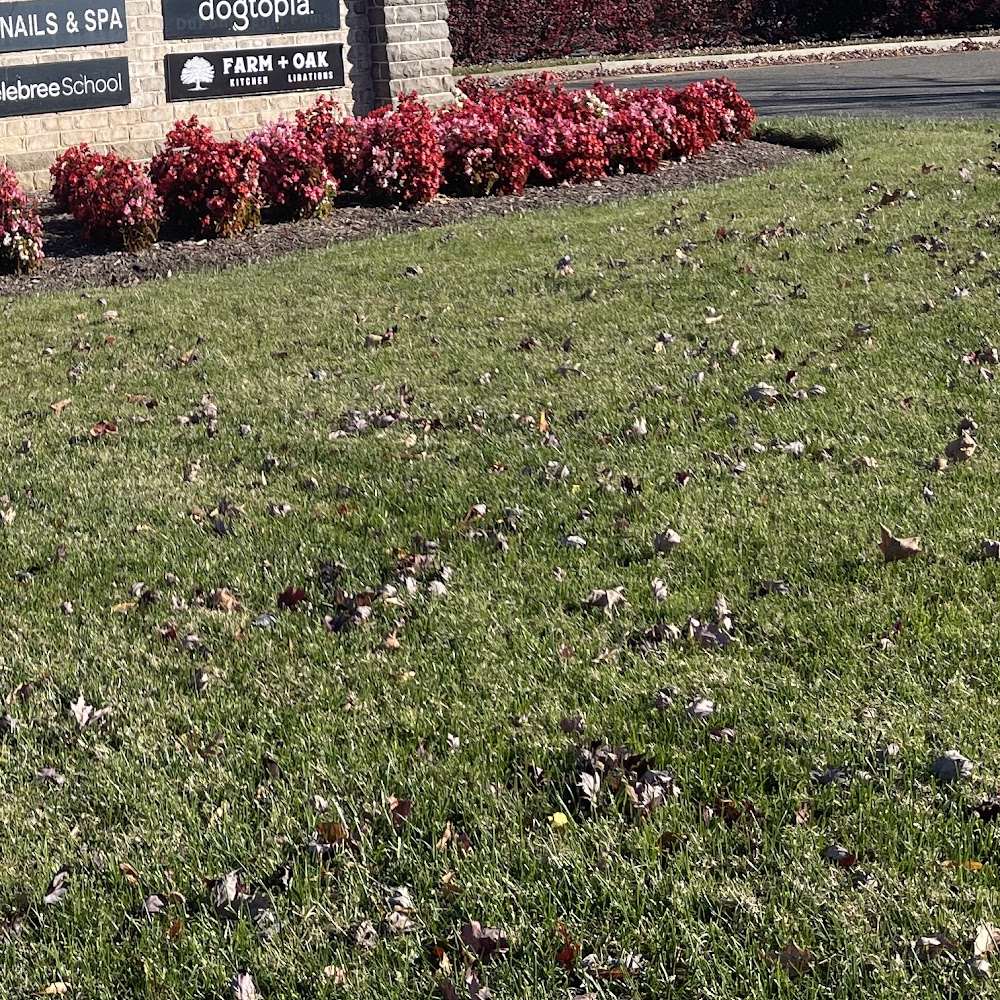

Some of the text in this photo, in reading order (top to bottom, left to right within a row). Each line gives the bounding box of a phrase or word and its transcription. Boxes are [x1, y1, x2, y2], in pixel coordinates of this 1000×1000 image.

[0, 12, 58, 39] NAILS
[66, 11, 79, 33] &
[84, 7, 123, 32] SPA
[222, 55, 273, 75] FARM
[293, 51, 329, 69] OAK
[229, 71, 334, 87] KITCHEN LIBATIONS
